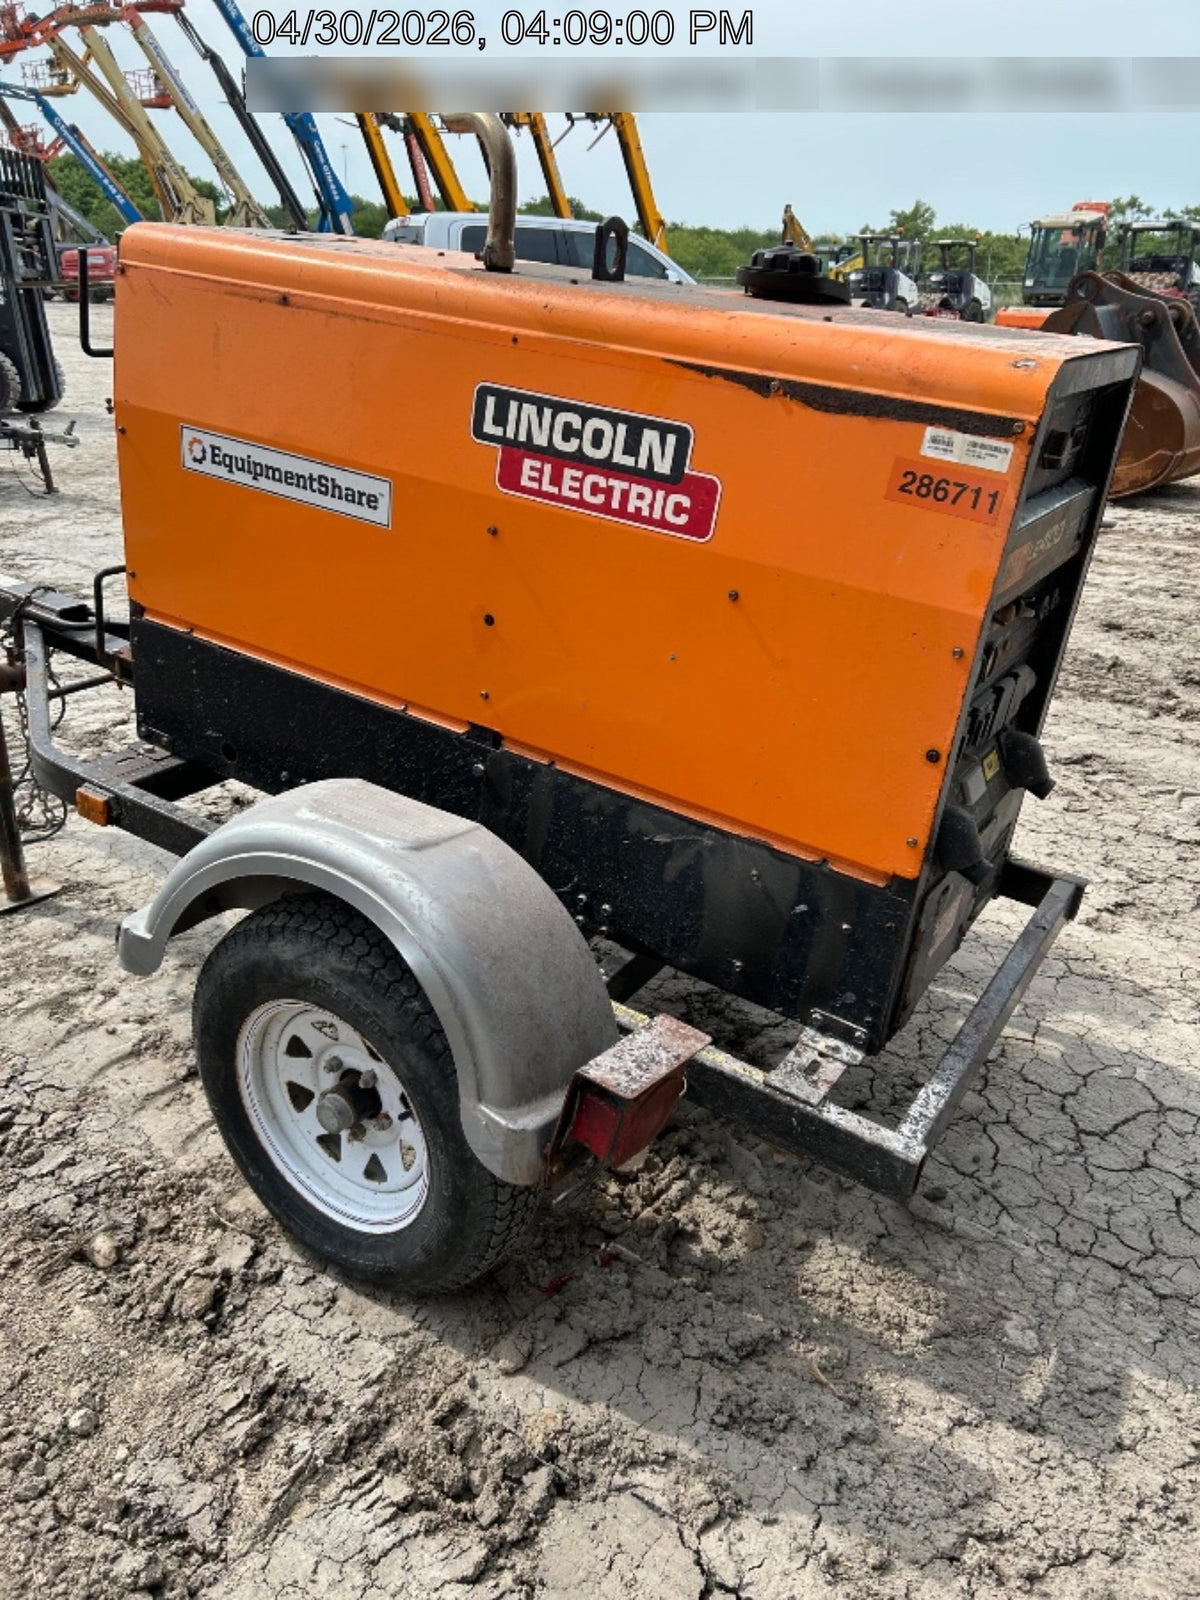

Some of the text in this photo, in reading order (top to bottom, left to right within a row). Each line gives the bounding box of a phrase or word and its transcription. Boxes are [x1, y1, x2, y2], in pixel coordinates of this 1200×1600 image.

[482, 395, 677, 475] LINCOLN
[520, 457, 691, 526] ELECTRIC
[897, 470, 1000, 515] 286711
